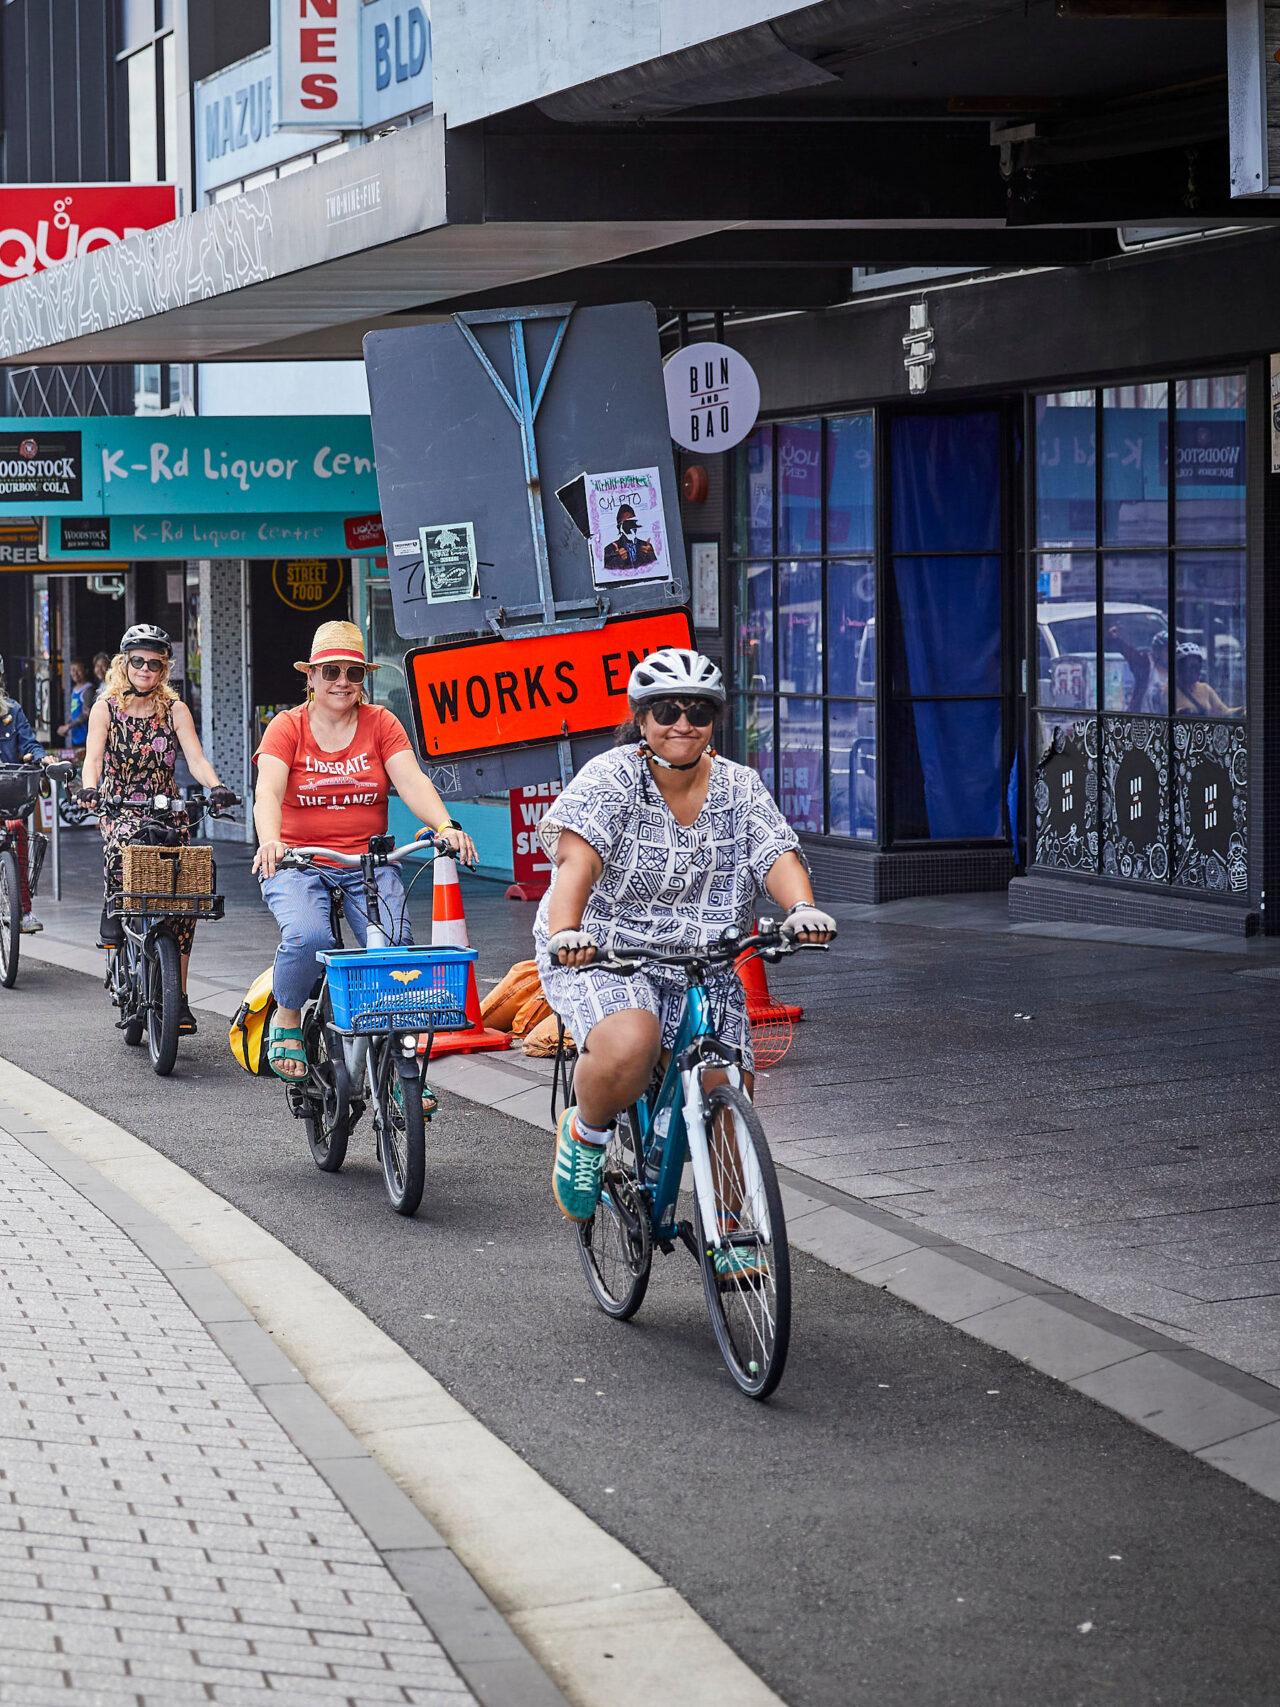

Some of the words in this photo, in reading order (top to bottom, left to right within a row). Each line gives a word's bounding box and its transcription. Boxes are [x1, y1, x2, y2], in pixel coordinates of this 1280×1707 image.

[375, 7, 433, 92] BLD
[690, 357, 729, 394] BUN
[701, 394, 719, 405] AND
[691, 406, 729, 442] BAO
[101, 442, 188, 484] K-Rd
[203, 447, 298, 491] Liquor
[313, 446, 376, 479] Cen
[42, 482, 70, 494] COLA
[132, 520, 184, 543] K-Rd
[193, 523, 247, 547] Liquor
[258, 523, 324, 541] Centre
[287, 566, 328, 582] STREET
[292, 583, 323, 600] FOOD
[428, 660, 579, 724] WORKS
[602, 645, 675, 697] EN
[305, 752, 371, 776] LIBERATE
[296, 794, 327, 807] THE
[332, 793, 379, 806] LANE!
